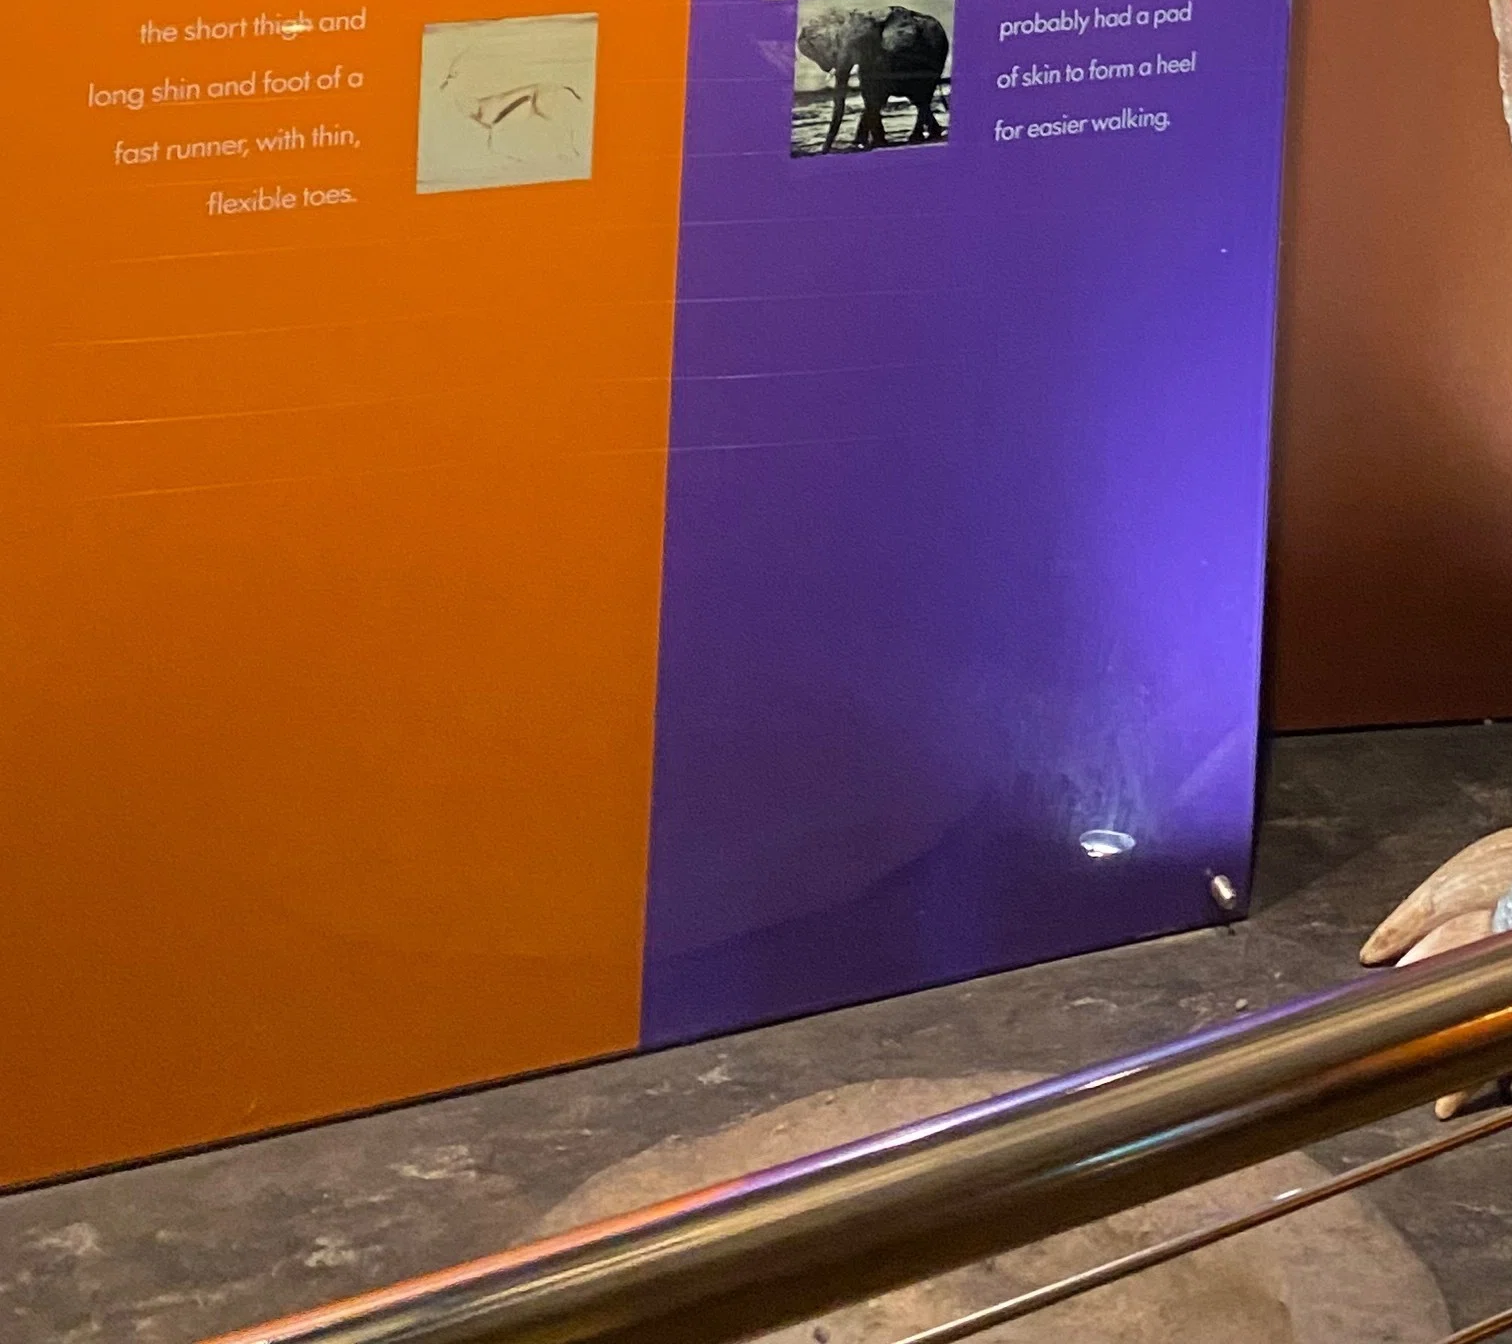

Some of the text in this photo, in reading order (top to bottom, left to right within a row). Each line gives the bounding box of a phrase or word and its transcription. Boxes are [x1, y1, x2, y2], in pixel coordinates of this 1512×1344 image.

[139, 19, 179, 44] the
[183, 16, 249, 42] short
[318, 6, 367, 33] and
[998, 0, 1193, 43] probably had a pad
[87, 64, 365, 111] long shin and foot of a
[995, 50, 1197, 90] of skin to form a heel
[113, 123, 361, 165] fast runner, with thin,
[993, 107, 1171, 142] for easier walking.
[206, 185, 358, 216] flexible toes.
